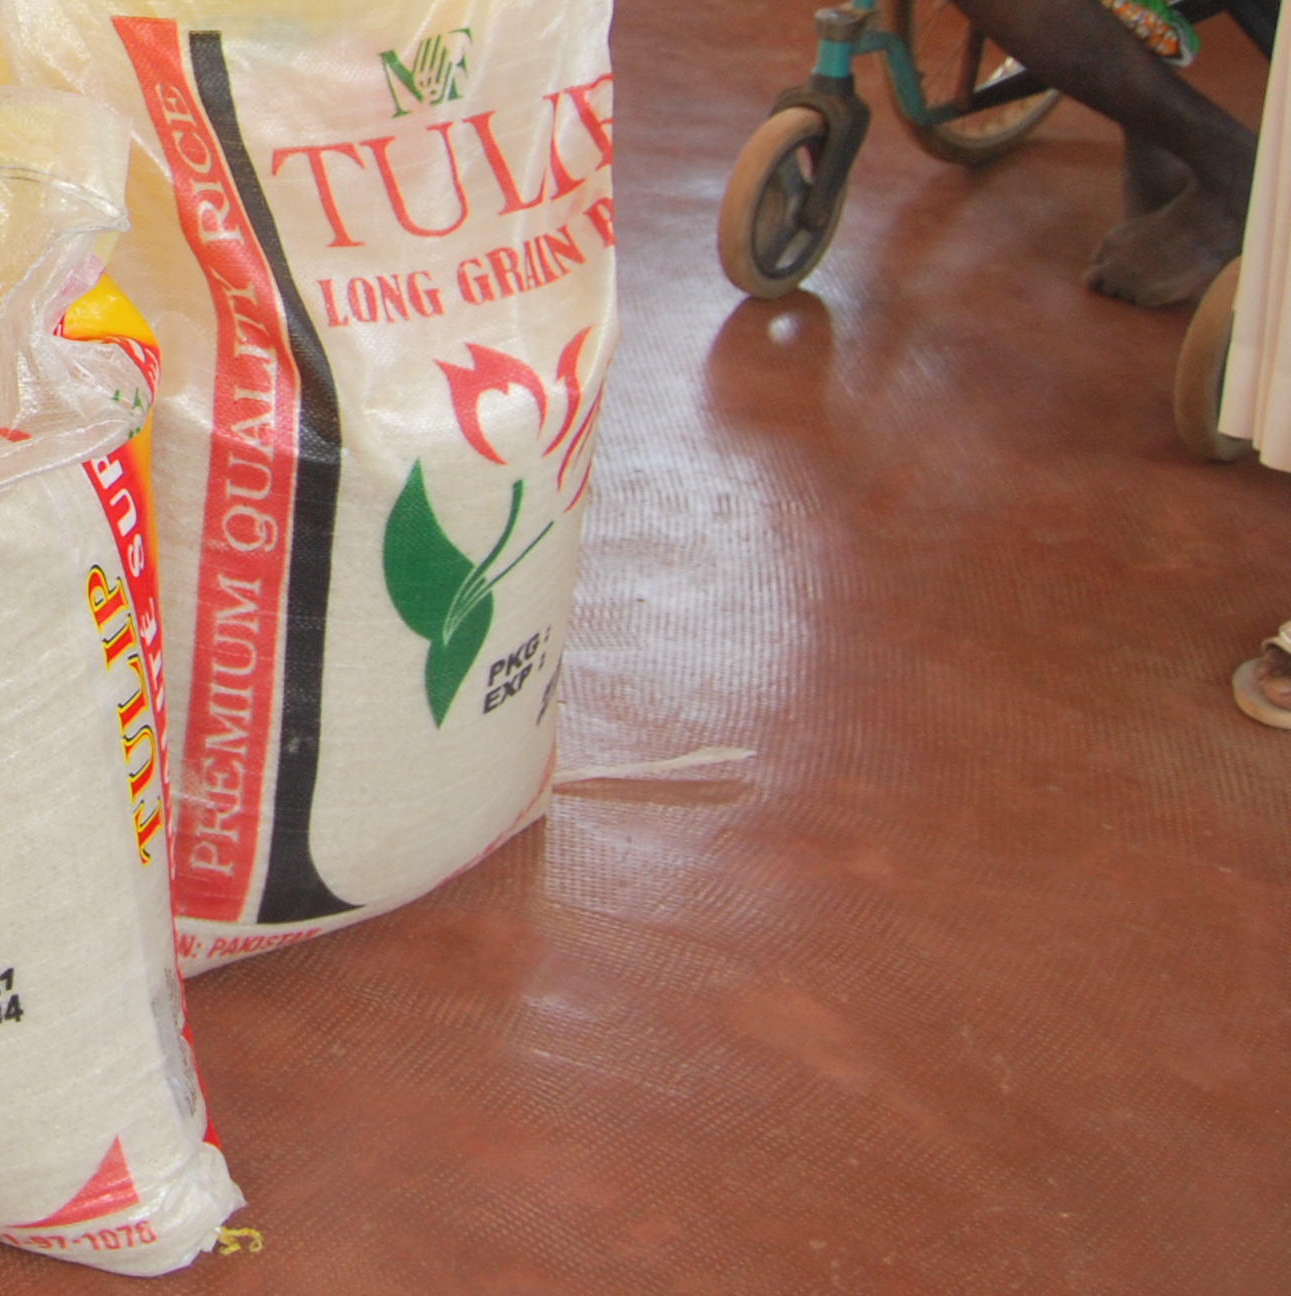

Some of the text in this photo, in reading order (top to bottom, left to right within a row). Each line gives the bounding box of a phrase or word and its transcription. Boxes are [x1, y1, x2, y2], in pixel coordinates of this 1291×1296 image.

[317, 224, 587, 328] LONG GRAIN
[154, 83, 280, 878] PREMIUM QUALITY RICE
[482, 662, 533, 715] EXP
[487, 631, 540, 687] PKG
[85, 563, 165, 867] TULIP
